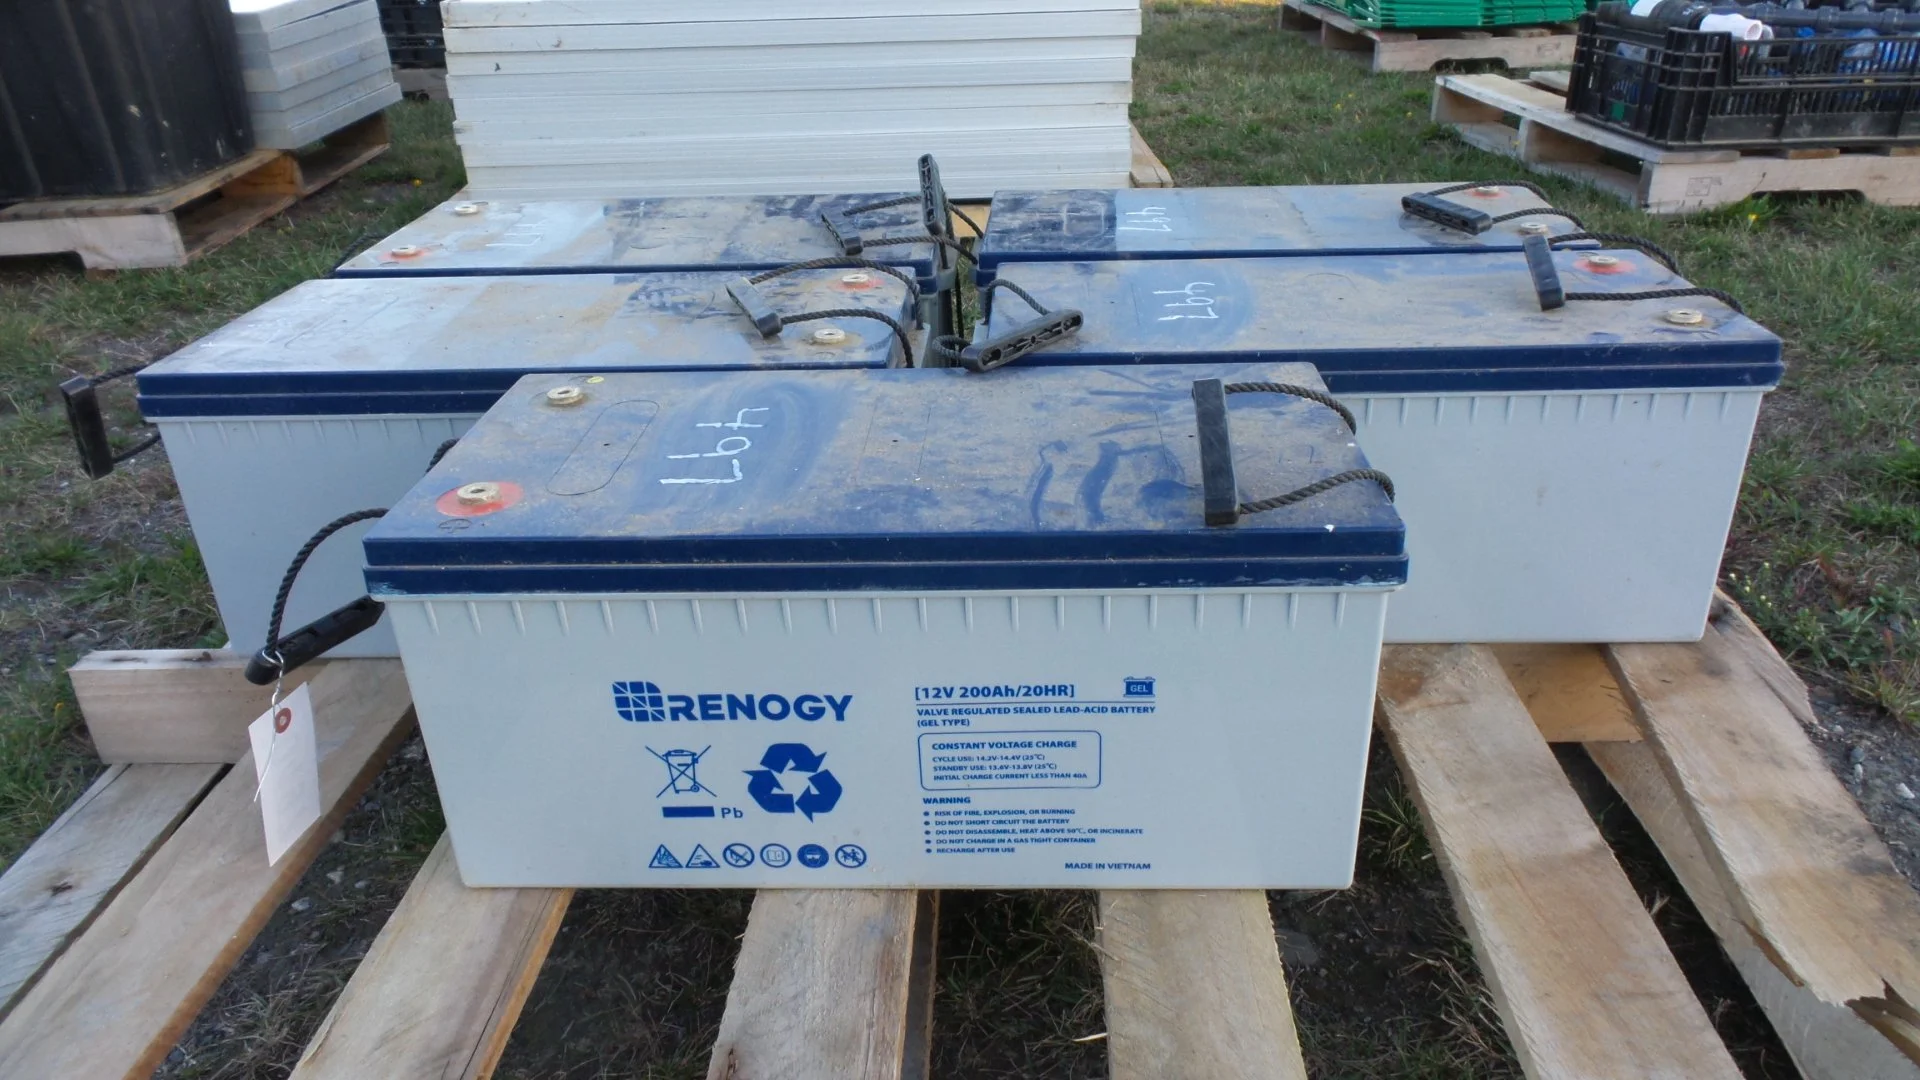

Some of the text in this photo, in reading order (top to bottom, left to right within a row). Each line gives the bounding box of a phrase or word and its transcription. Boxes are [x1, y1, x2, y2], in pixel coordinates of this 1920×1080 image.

[659, 407, 770, 485] 497
[915, 684, 1074, 700] [12V 200Ah/20HR]
[1130, 685, 1149, 693] GEL
[667, 694, 852, 722] RENOGY
[917, 705, 1155, 716] VALVE REGULATED SEALED LEAD-ACID BATTERY
[918, 718, 970, 727] (GEL TYPE)
[932, 741, 1076, 750] CONSTANT VOLTAGE CHARGE
[721, 807, 744, 818] Pb
